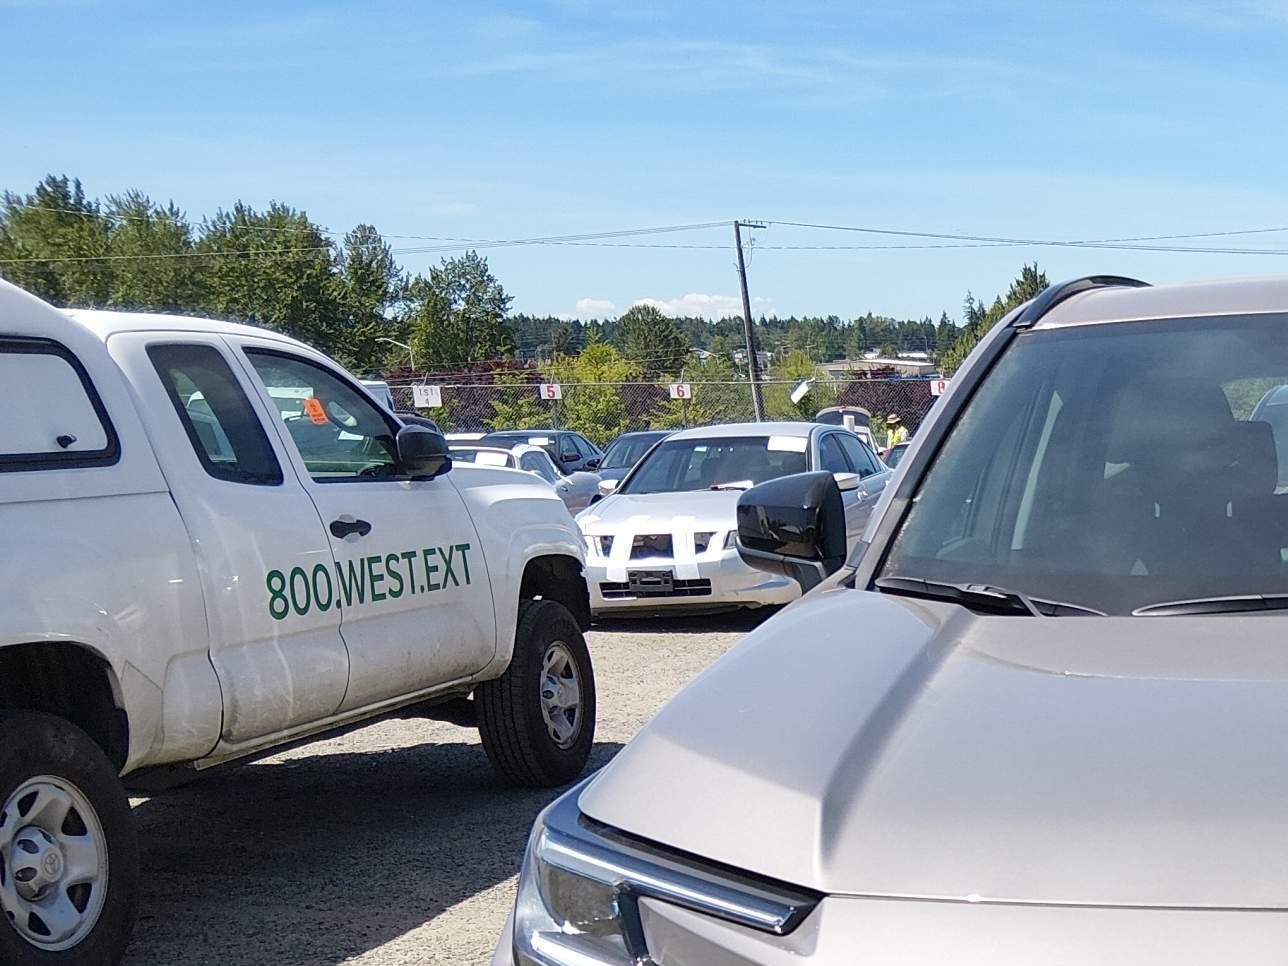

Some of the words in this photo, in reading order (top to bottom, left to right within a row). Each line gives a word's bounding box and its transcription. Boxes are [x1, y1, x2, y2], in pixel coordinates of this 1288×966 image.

[546, 385, 556, 399] 5
[676, 384, 685, 398] 6
[266, 543, 471, 621] 800.WEST.EXT
